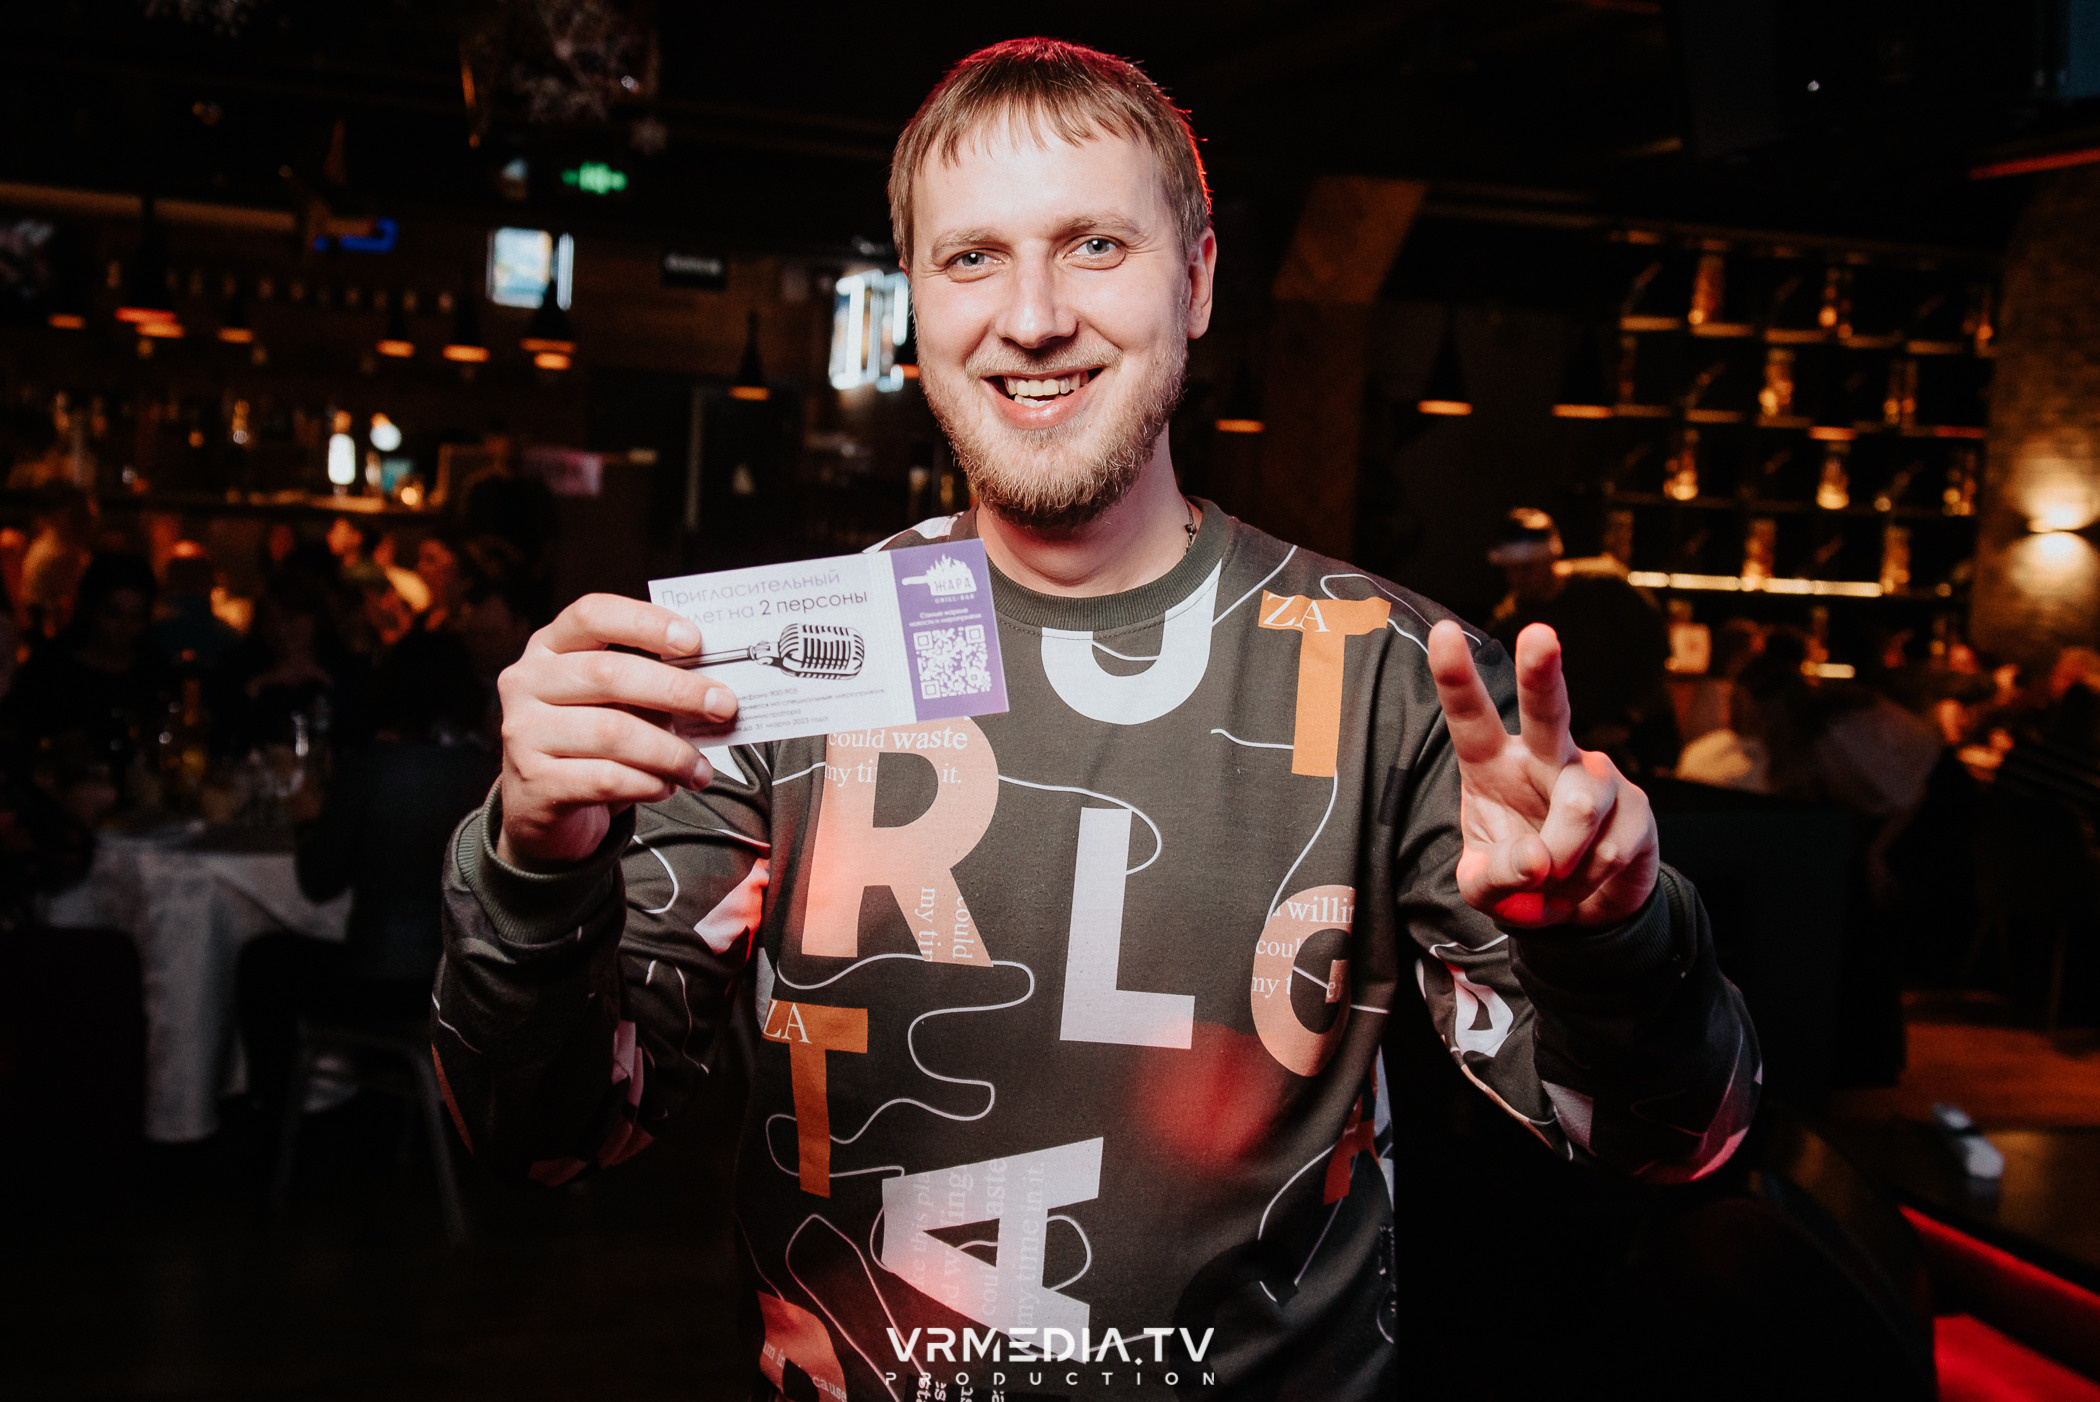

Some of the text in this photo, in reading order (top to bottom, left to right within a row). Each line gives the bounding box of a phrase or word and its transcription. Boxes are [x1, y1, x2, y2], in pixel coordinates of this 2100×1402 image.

[661, 569, 840, 608] Пригласительный
[934, 577, 972, 593] ЖАРА
[687, 592, 868, 625] лет на 2 персоны
[1264, 593, 1331, 633] ZA
[828, 726, 968, 750] could waste
[914, 887, 935, 923] my
